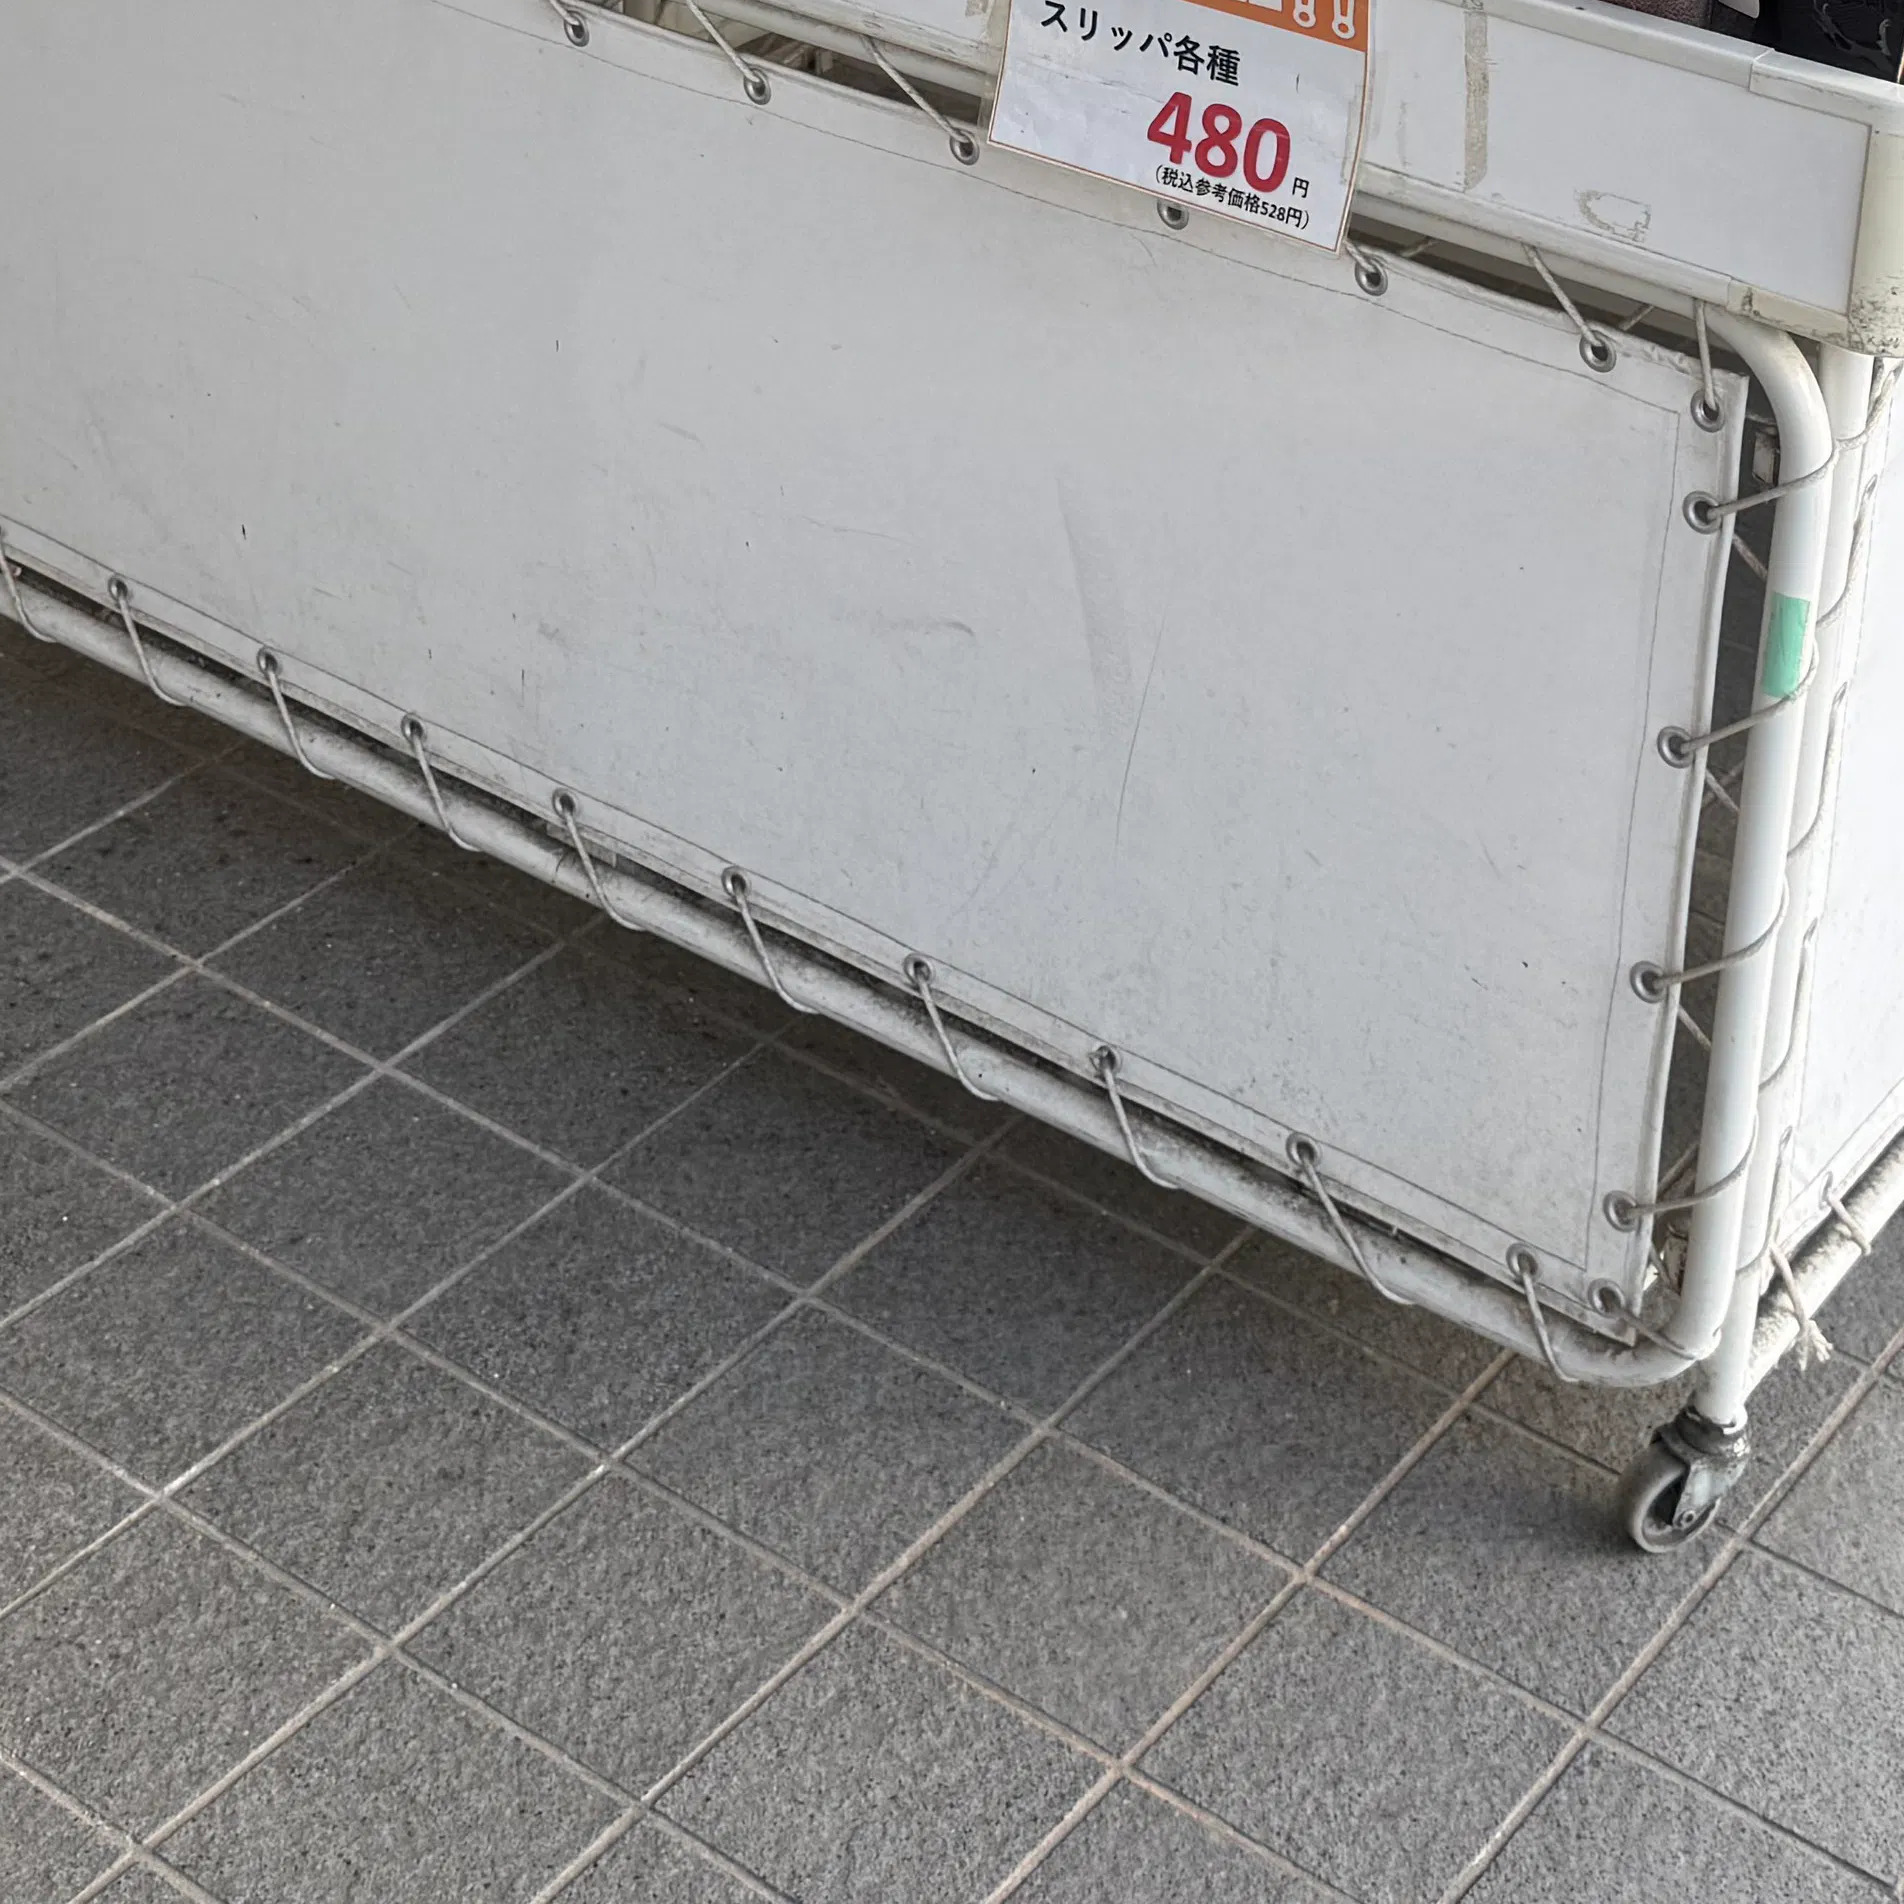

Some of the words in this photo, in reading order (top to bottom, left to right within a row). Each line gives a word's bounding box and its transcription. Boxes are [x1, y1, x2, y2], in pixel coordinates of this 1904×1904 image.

[1041, 0, 1241, 87] スリッパ各種
[1156, 164, 1309, 230] (税込参考価格528円)
